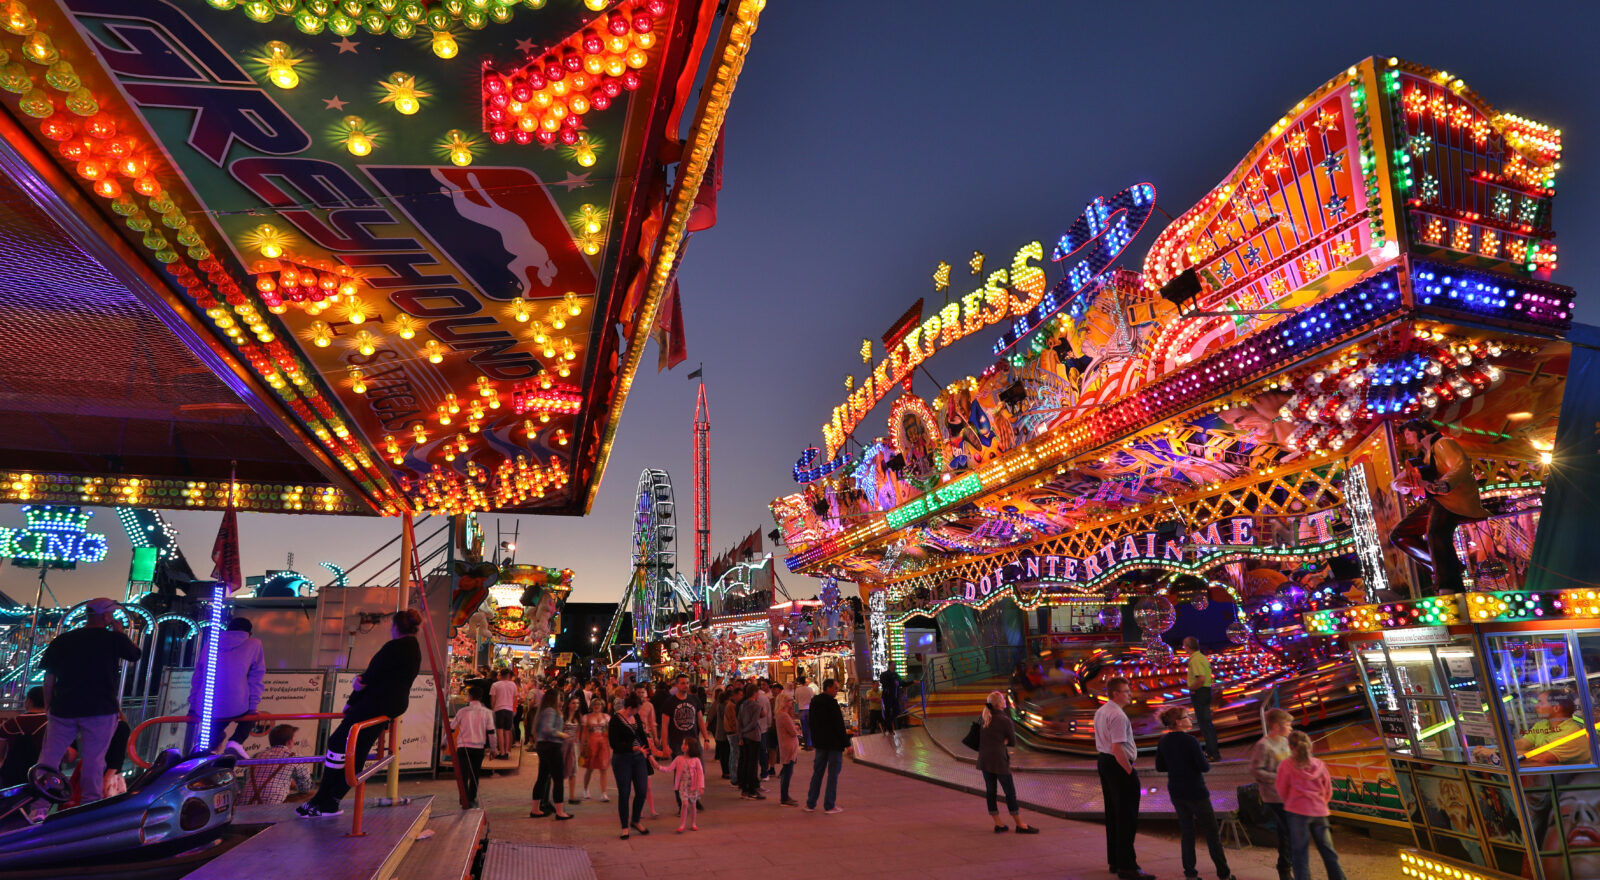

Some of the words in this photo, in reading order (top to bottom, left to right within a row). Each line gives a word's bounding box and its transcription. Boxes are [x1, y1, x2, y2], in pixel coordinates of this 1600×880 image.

[71, 0, 543, 382] GREYHOUND
[360, 364, 427, 431] VEGAS
[822, 358, 893, 461] MUSIK
[889, 241, 1047, 384] EXPRESS
[1010, 509, 1339, 583] NTERTAINMENT
